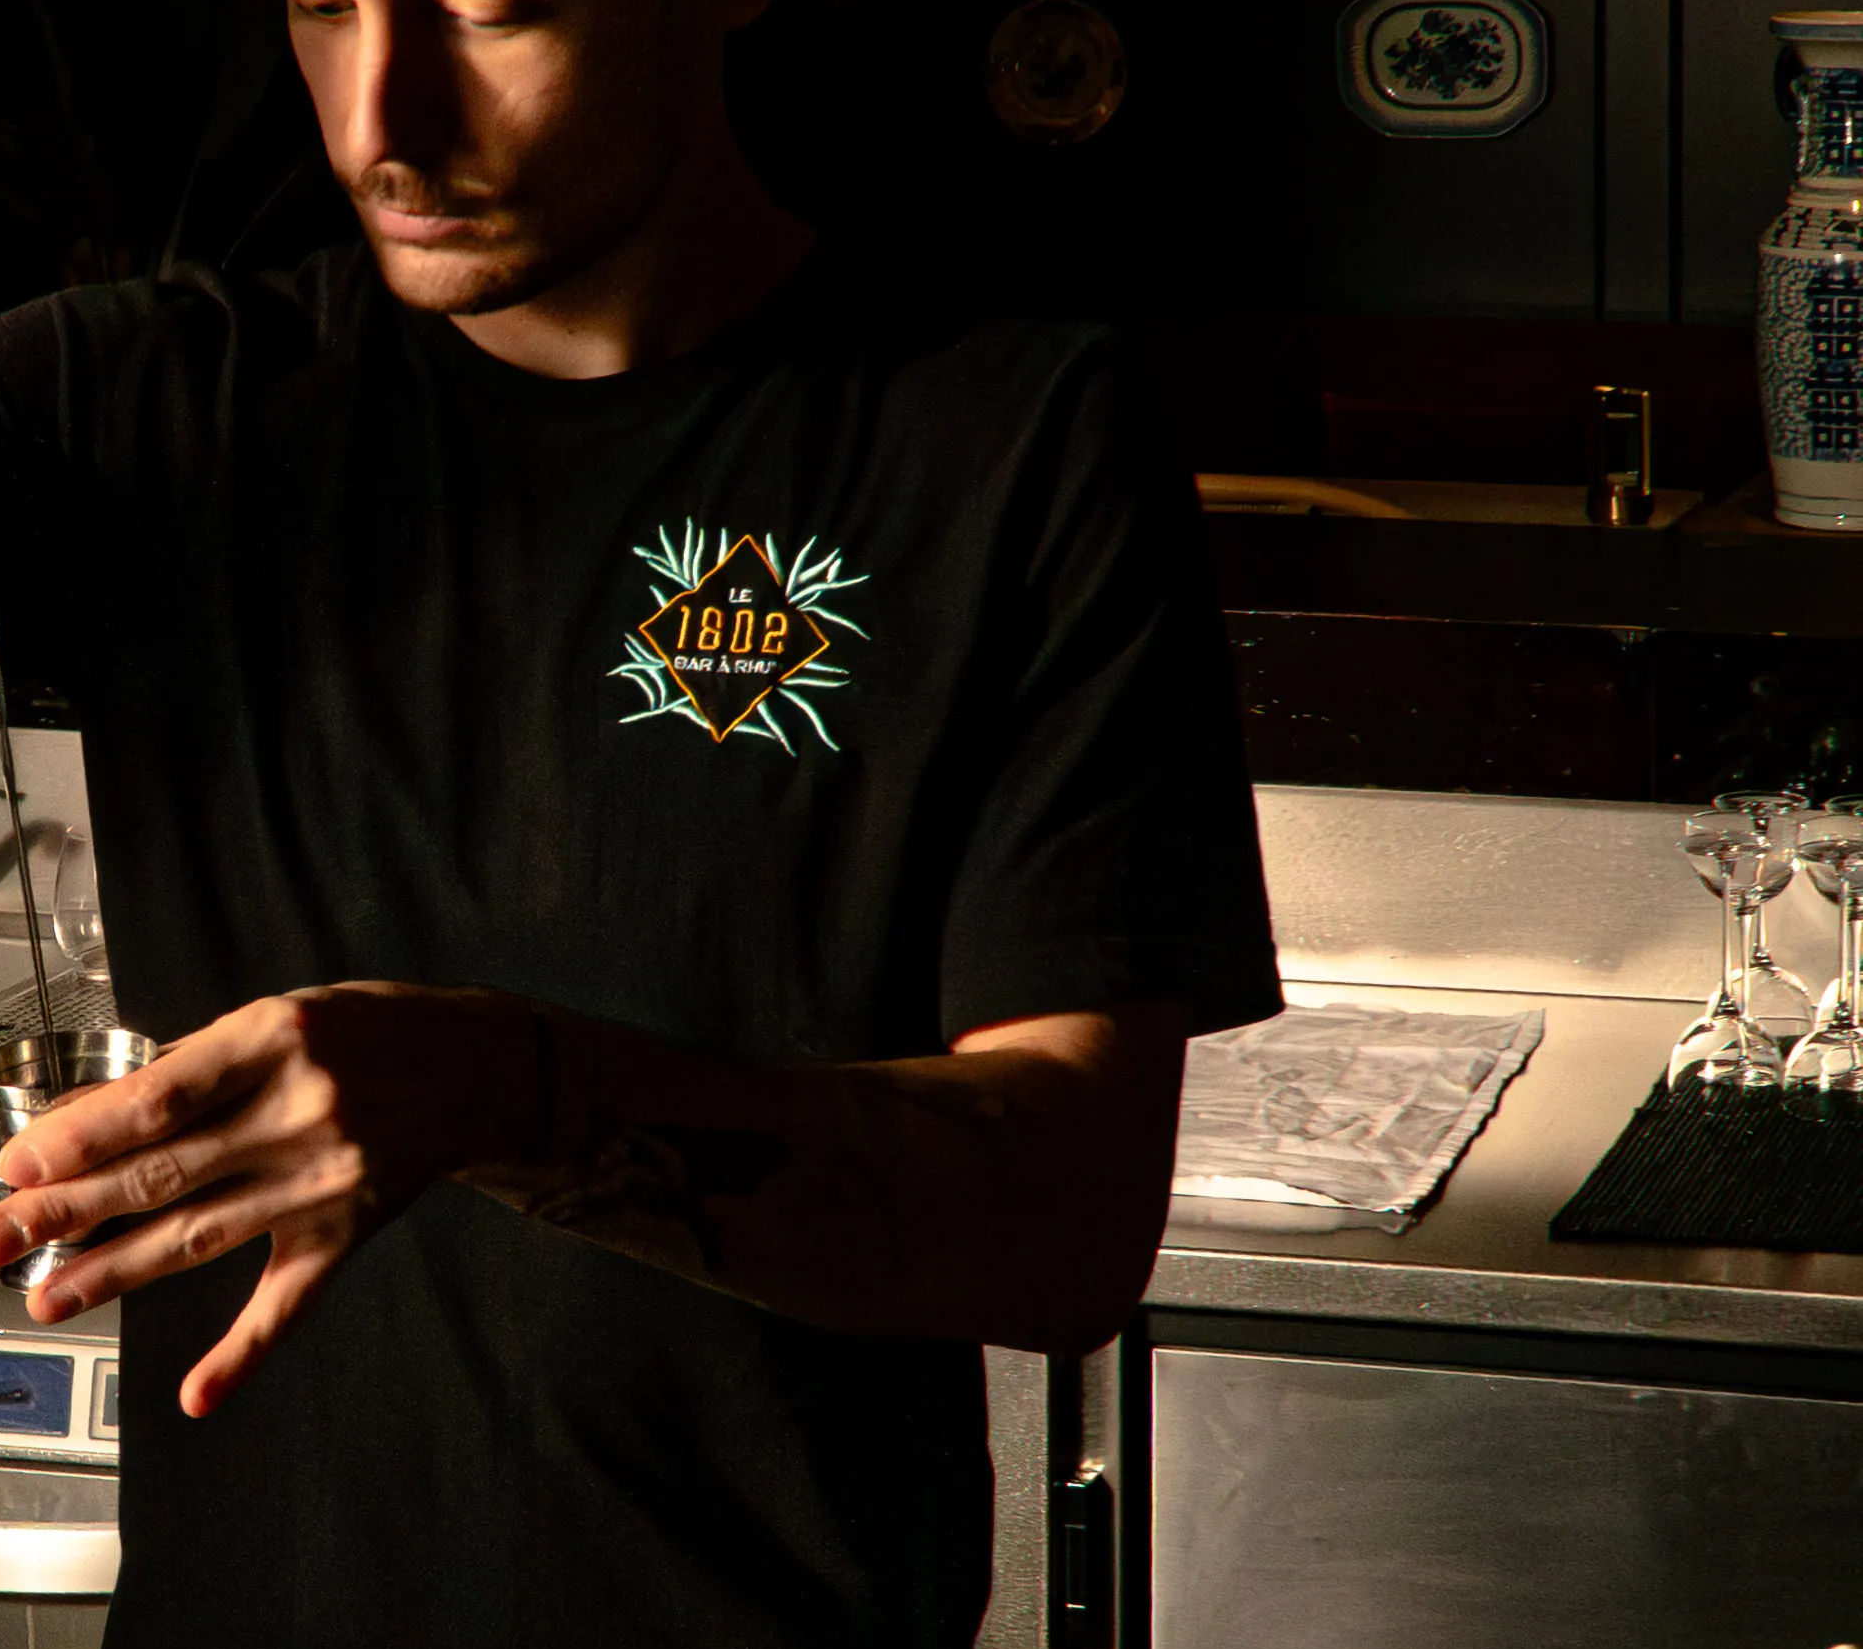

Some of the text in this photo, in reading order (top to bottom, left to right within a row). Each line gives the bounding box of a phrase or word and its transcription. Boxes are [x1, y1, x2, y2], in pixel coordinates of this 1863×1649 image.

[729, 587, 753, 604] LE
[677, 605, 788, 654] 1802
[673, 654, 714, 671] BAR
[734, 658, 777, 674] RHU
